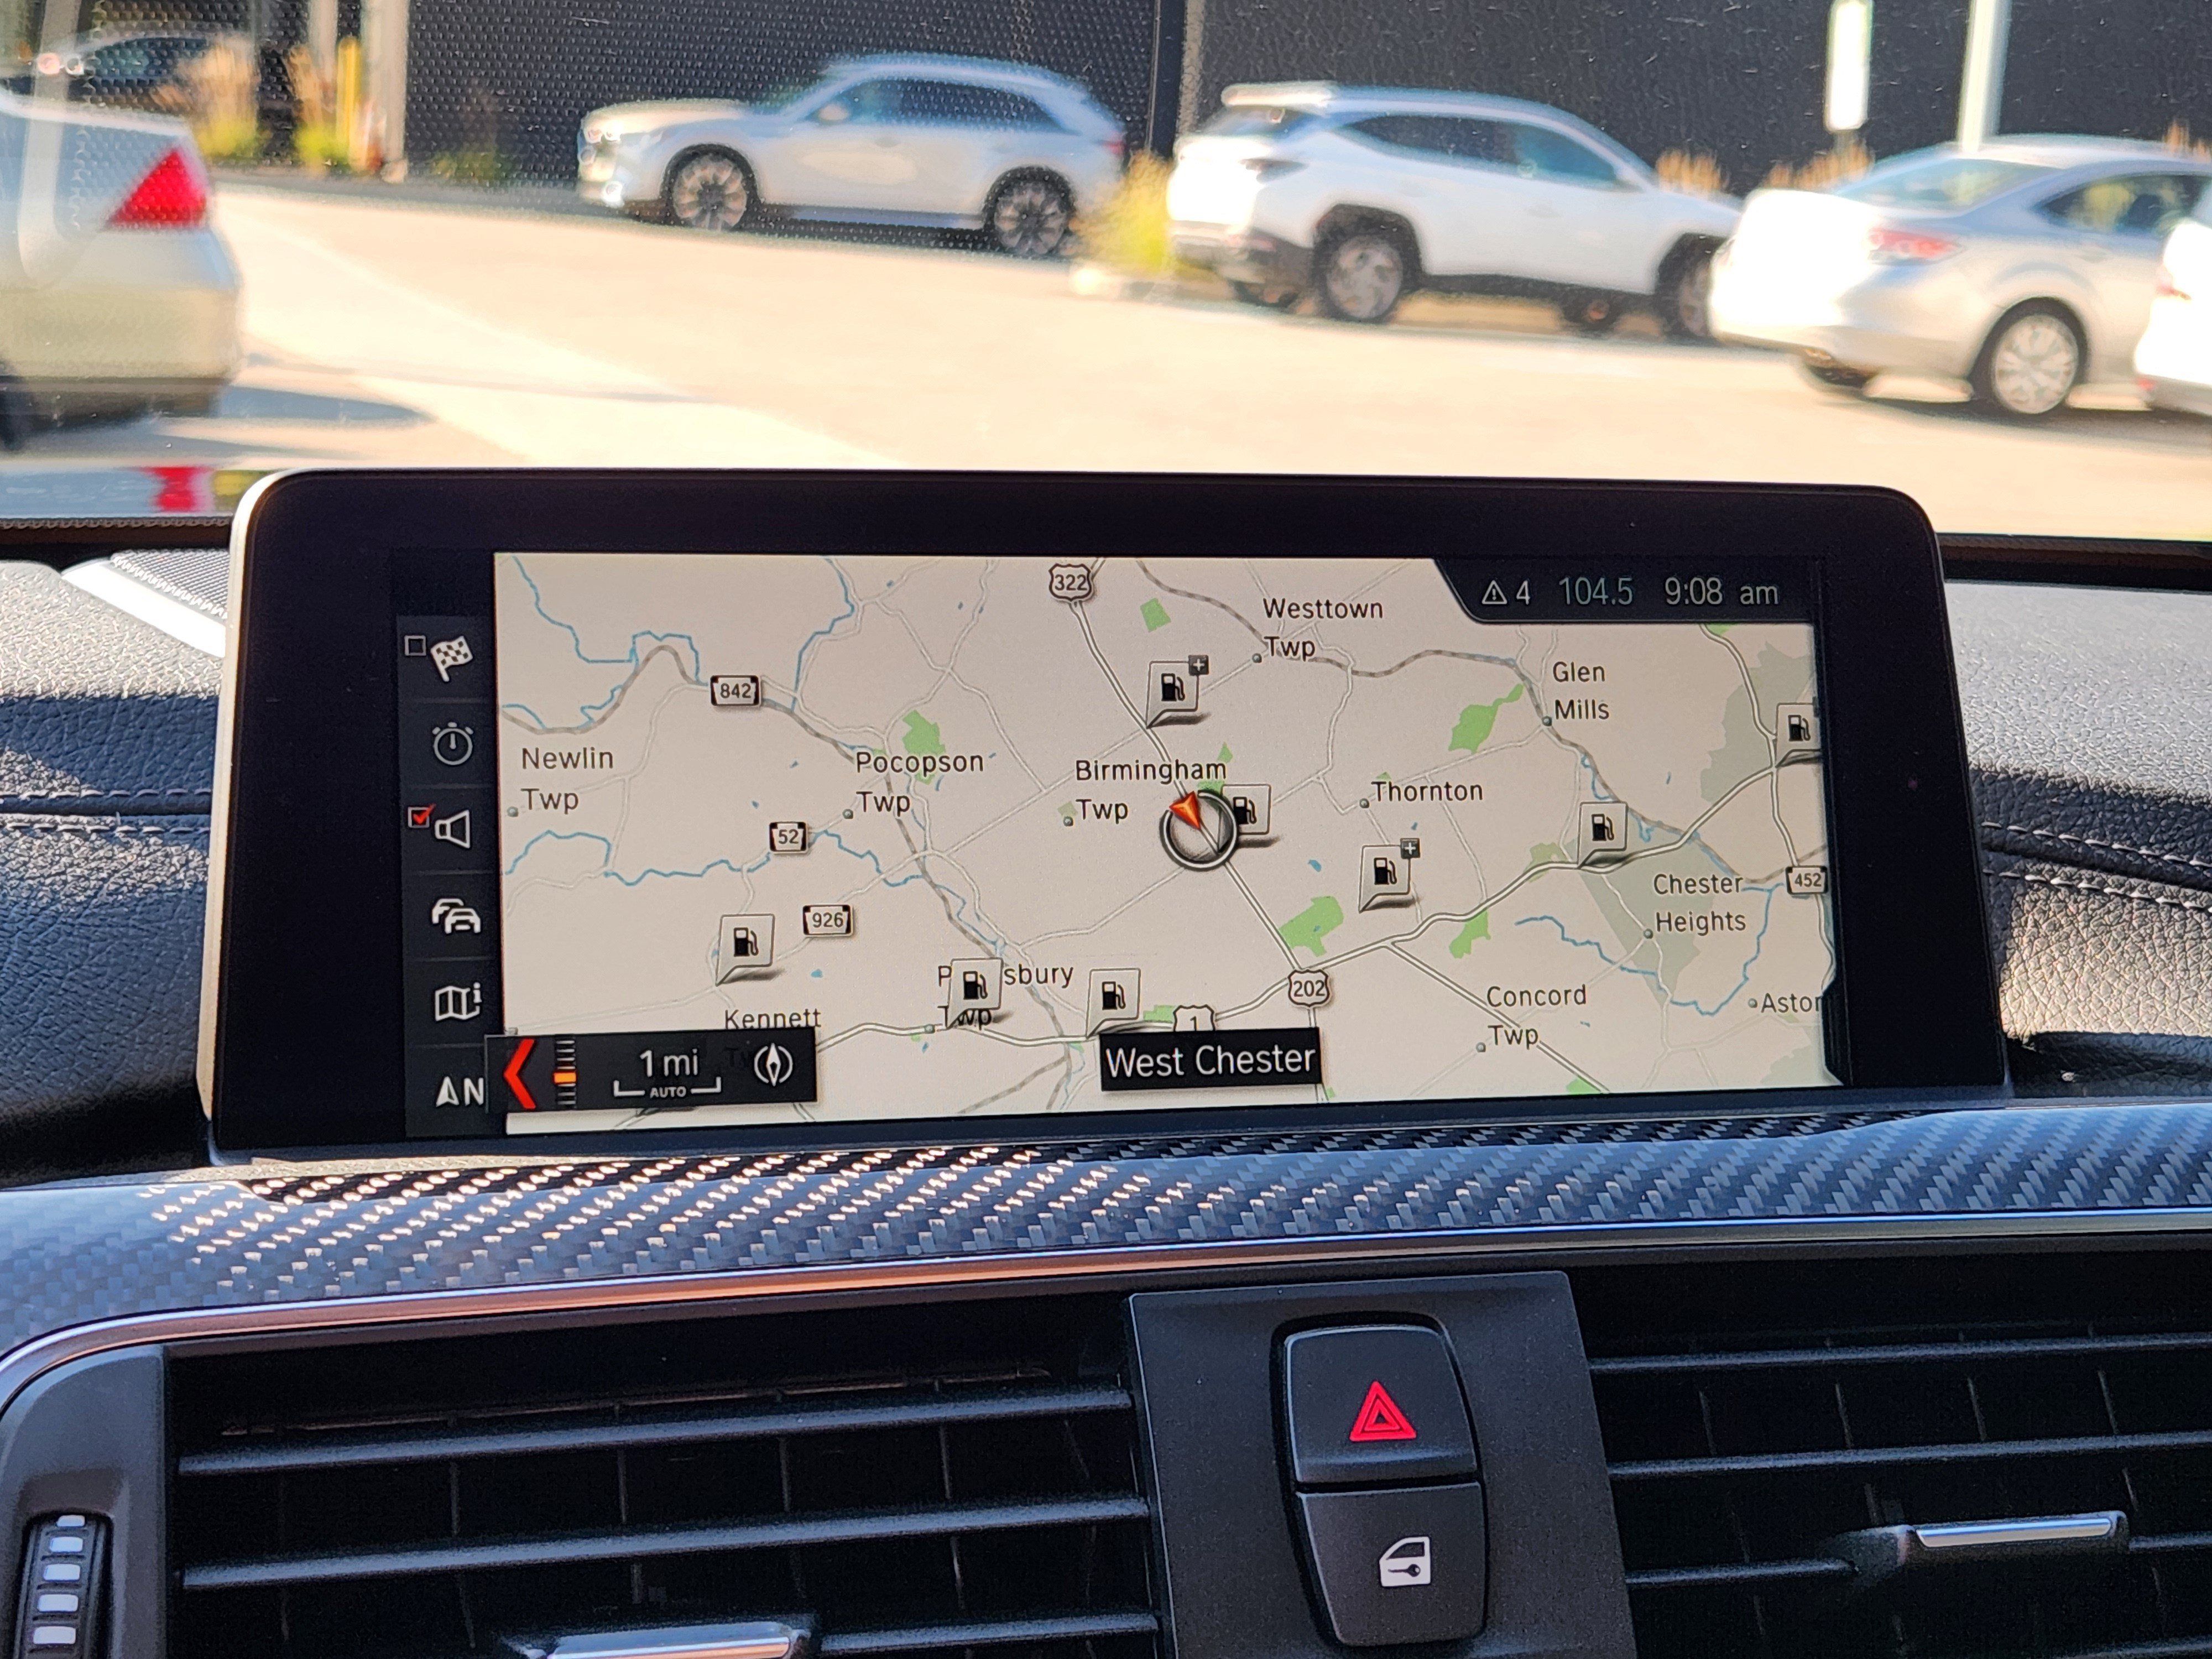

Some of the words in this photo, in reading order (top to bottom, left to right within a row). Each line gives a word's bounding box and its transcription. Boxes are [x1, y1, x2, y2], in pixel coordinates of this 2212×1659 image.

[1054, 573, 1088, 591] 322
[1516, 581, 1530, 605] 4
[1559, 577, 1633, 604] 104.5
[1665, 577, 1723, 605] 9:08
[1740, 585, 1778, 604] am
[1264, 598, 1383, 619] Westtown
[1265, 637, 1316, 661] Twp
[1552, 661, 1606, 682] Glen
[719, 683, 752, 700] 842
[1555, 700, 1610, 720] Mills
[521, 748, 613, 769] Newlin
[856, 752, 984, 776] Pocopson
[1076, 760, 1227, 785] Birmingham
[521, 789, 578, 813] Twp
[1371, 781, 1483, 801] Thornton
[857, 792, 911, 814] Twp
[1077, 800, 1128, 823] Twp
[778, 830, 800, 844] 52
[1653, 873, 1743, 894] Chester
[1794, 873, 1822, 887] 452
[811, 913, 844, 928] 926
[1656, 911, 1746, 936] Heights
[938, 963, 1074, 989] Psbury
[1294, 980, 1326, 998] 202
[1486, 984, 1587, 1005] Concord
[725, 1008, 821, 1029] Kennett
[1488, 1025, 1538, 1050] Twp
[640, 1051, 655, 1077] 1
[664, 1050, 699, 1075] mi
[1107, 1046, 1185, 1078] West
[1195, 1045, 1316, 1074] Chester
[464, 1077, 484, 1105] N
[650, 1086, 687, 1098] AUTO
